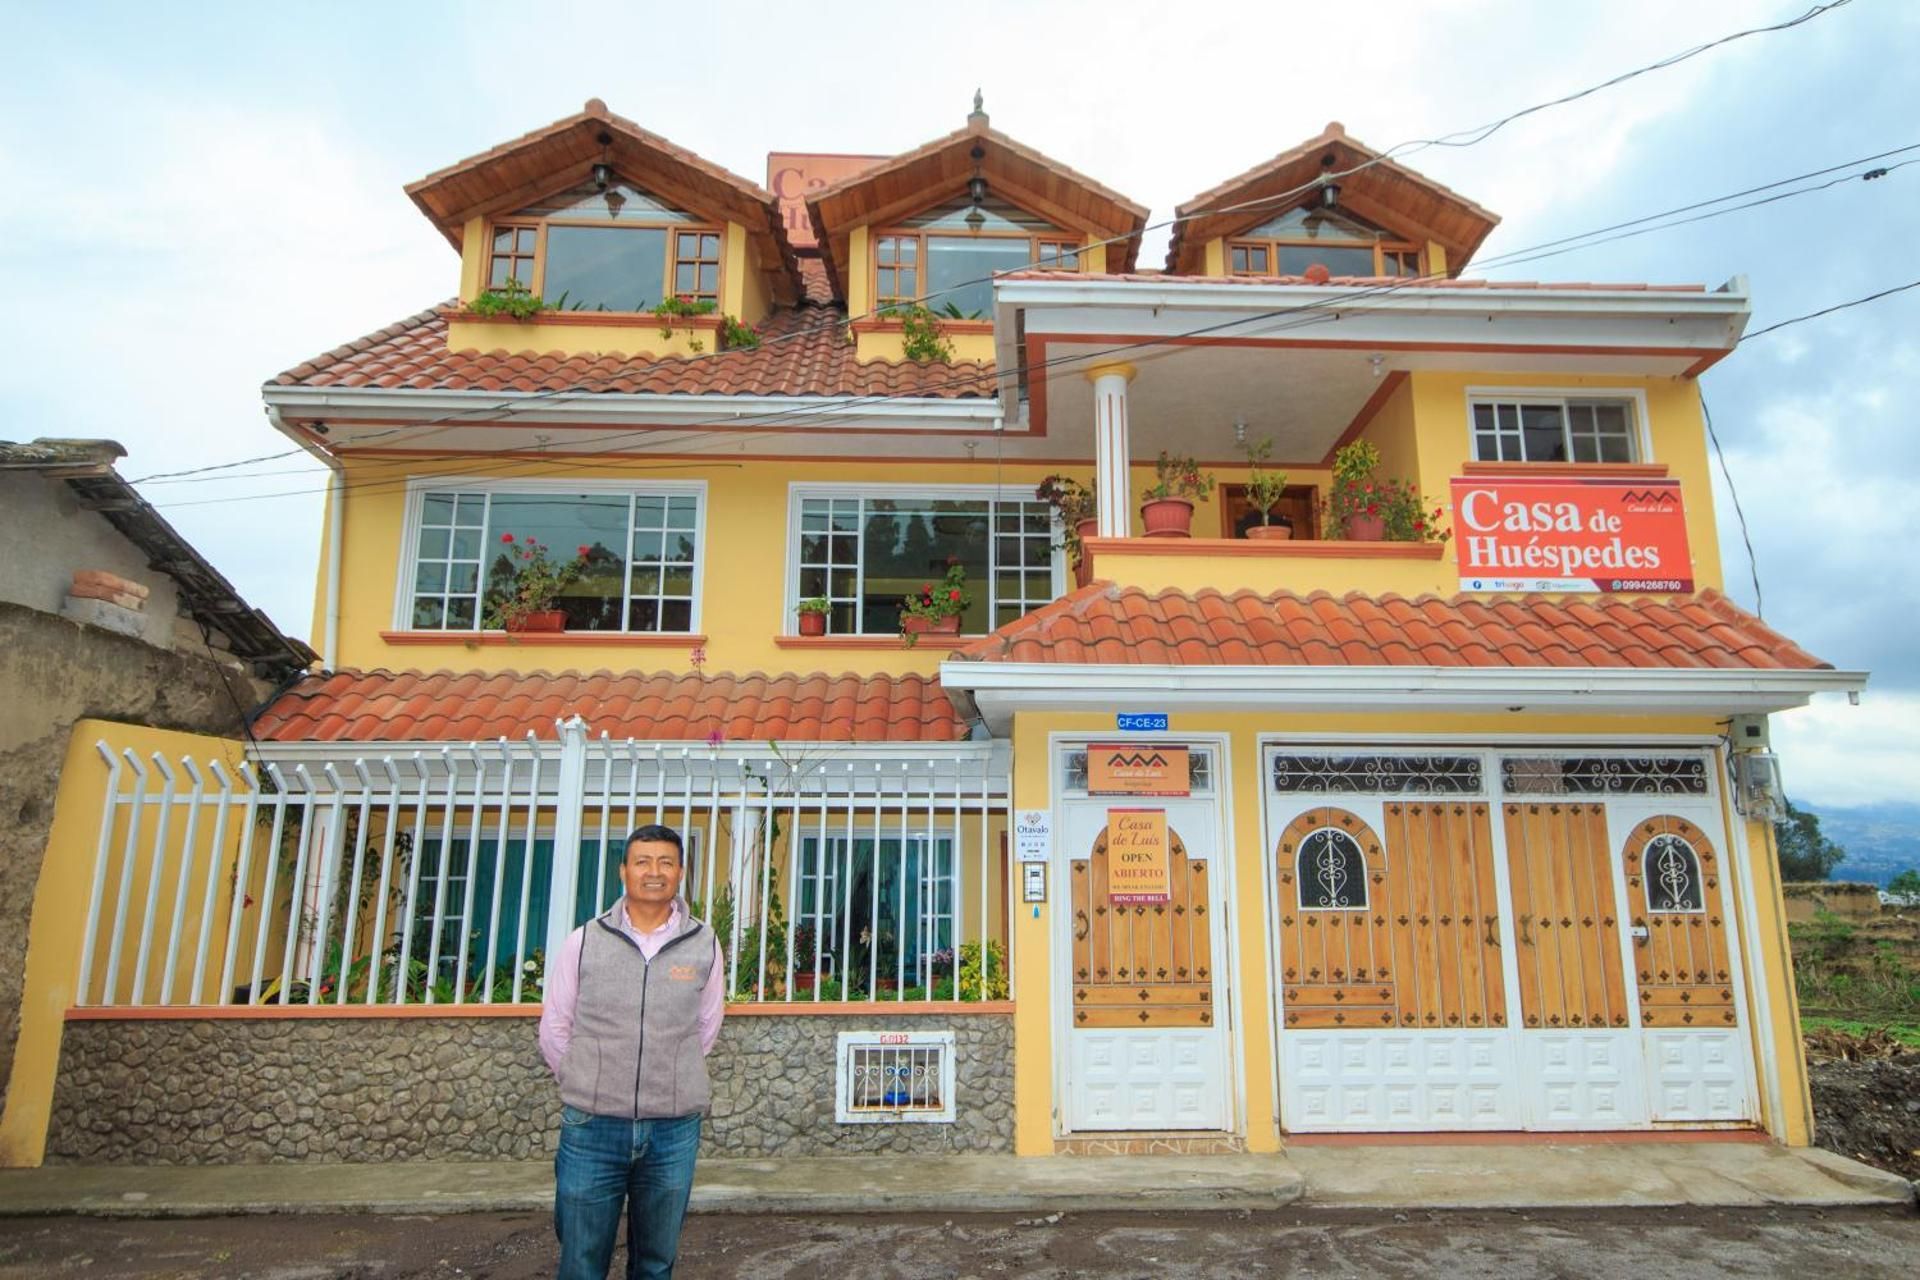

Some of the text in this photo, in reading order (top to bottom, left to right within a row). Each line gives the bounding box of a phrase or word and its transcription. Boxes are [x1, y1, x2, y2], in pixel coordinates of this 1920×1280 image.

[1461, 489, 1622, 532] Casa de
[1465, 535, 1660, 576] Huéspedes
[1118, 717, 1166, 728] CF-CE-23
[1017, 824, 1049, 834] Otavalo
[1118, 816, 1152, 831] Casa
[1112, 832, 1127, 846] de
[1121, 853, 1153, 863] OPEN
[1114, 868, 1164, 878] ABIERTO
